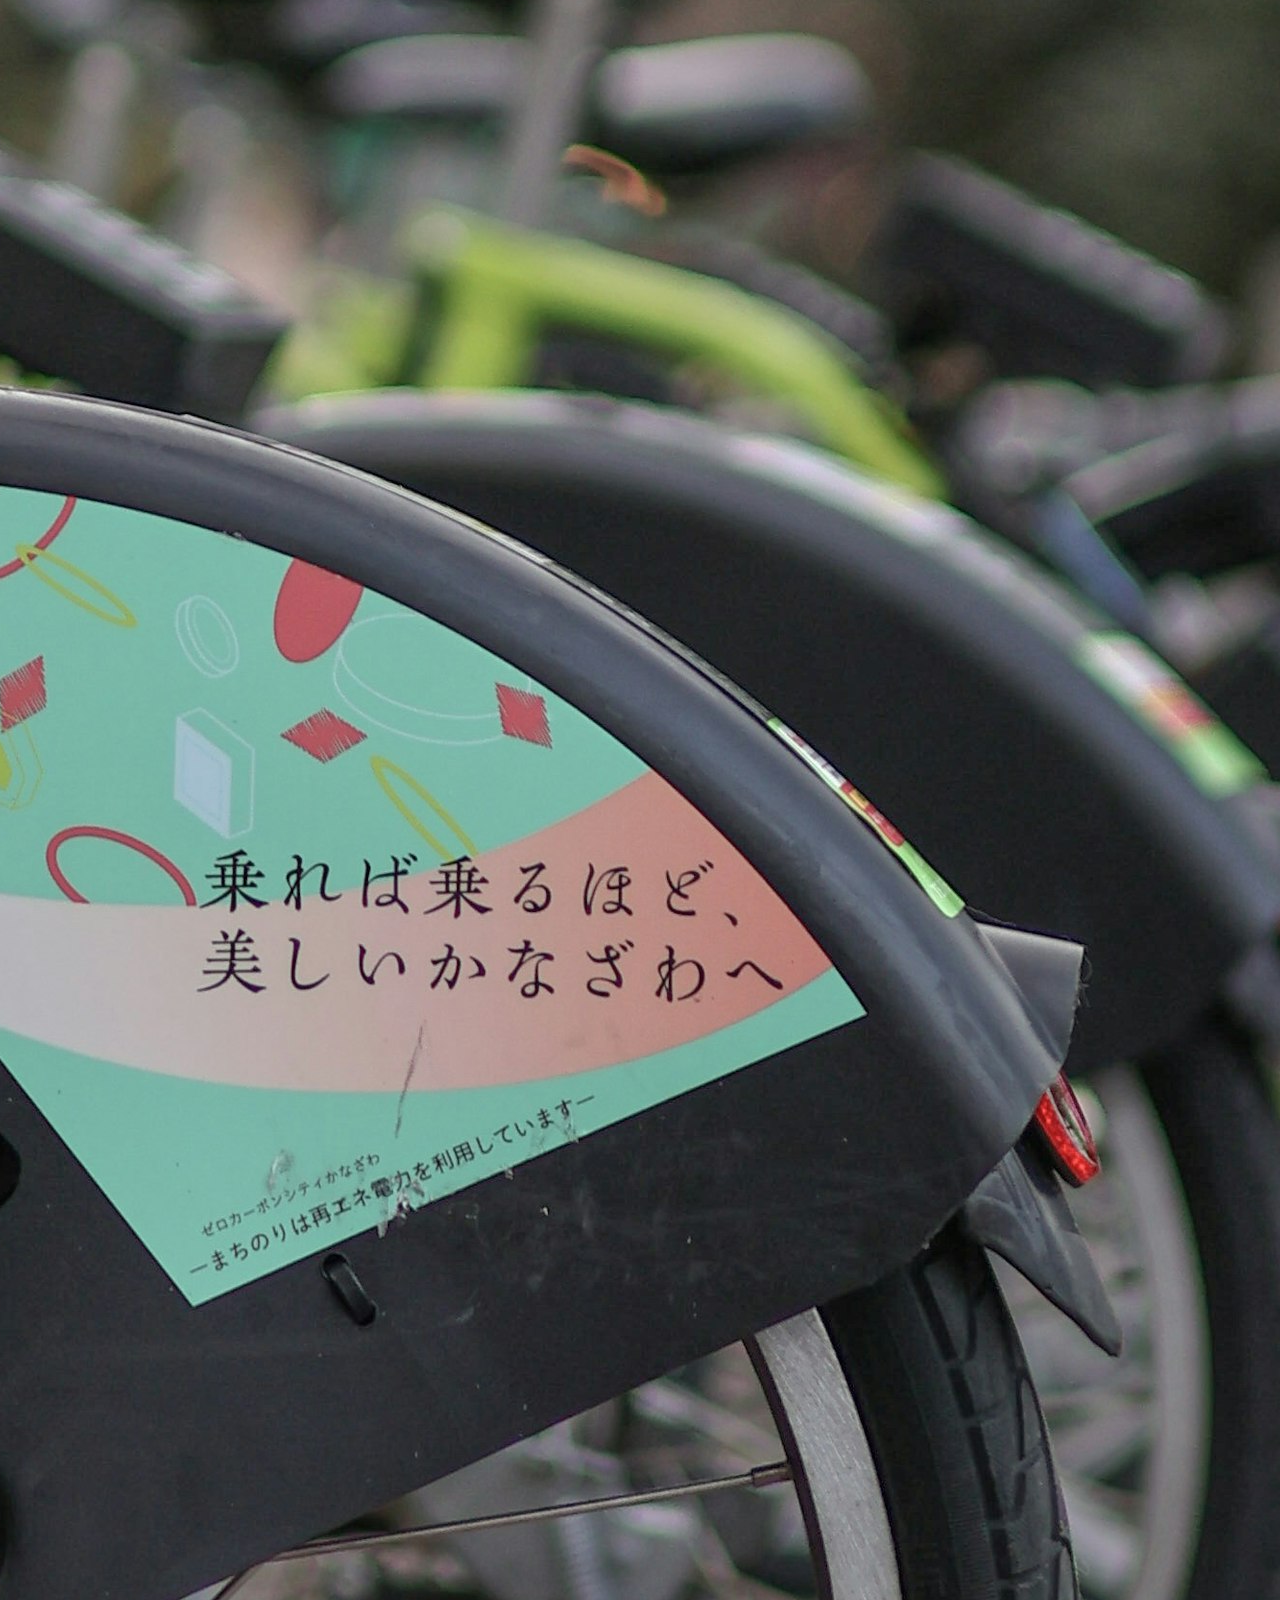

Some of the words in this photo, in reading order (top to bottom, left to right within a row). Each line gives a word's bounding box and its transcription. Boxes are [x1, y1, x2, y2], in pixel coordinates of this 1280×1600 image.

[198, 849, 740, 927] 乗れば乗るほど、
[196, 928, 784, 1002] 美しいかなざわへ
[201, 1153, 381, 1237] ゼロカーボンシティかなざわ
